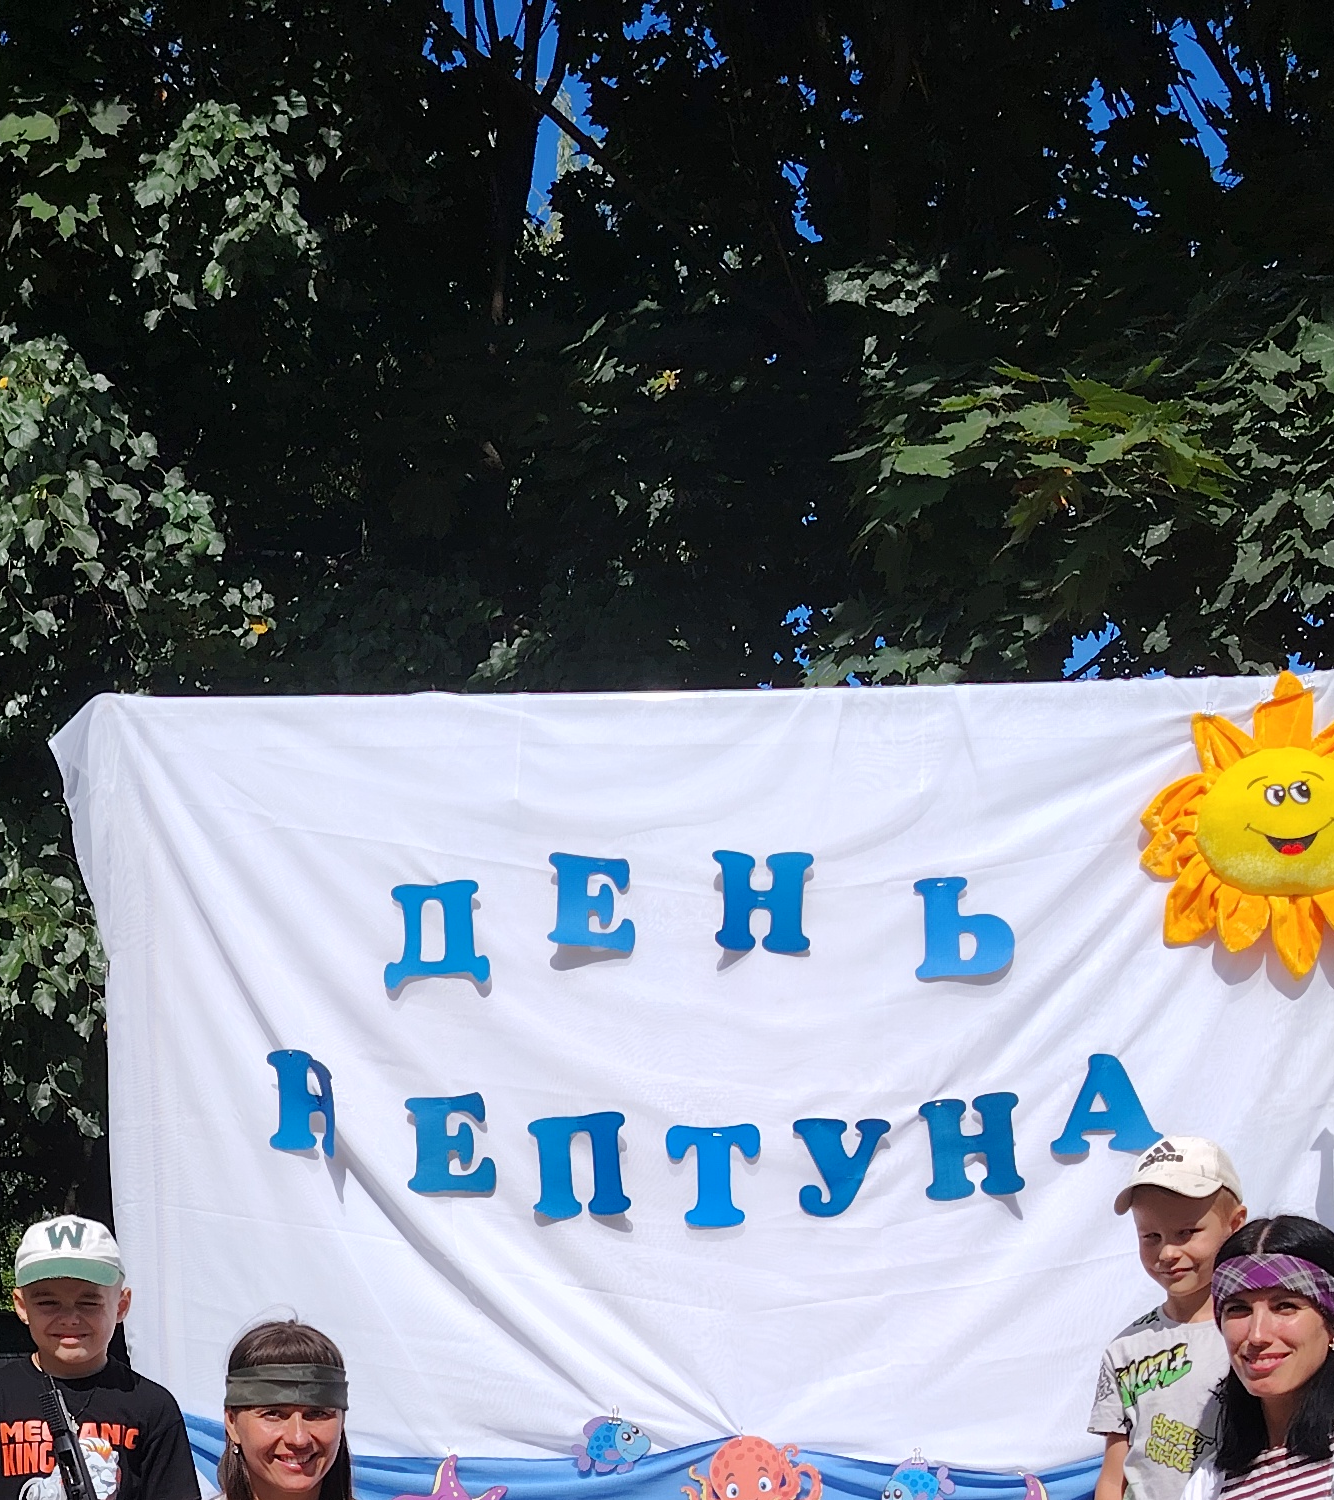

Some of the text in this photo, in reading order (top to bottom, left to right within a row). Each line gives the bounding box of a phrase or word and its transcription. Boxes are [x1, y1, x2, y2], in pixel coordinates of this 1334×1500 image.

[383, 849, 1015, 990] ДЕНЬ
[267, 1049, 1164, 1229] НЕПТУНА
[45, 1220, 88, 1251] W
[1151, 1412, 1217, 1455] STREET
[2, 1441, 55, 1477] KING
[1145, 1435, 1198, 1473] STYLE
